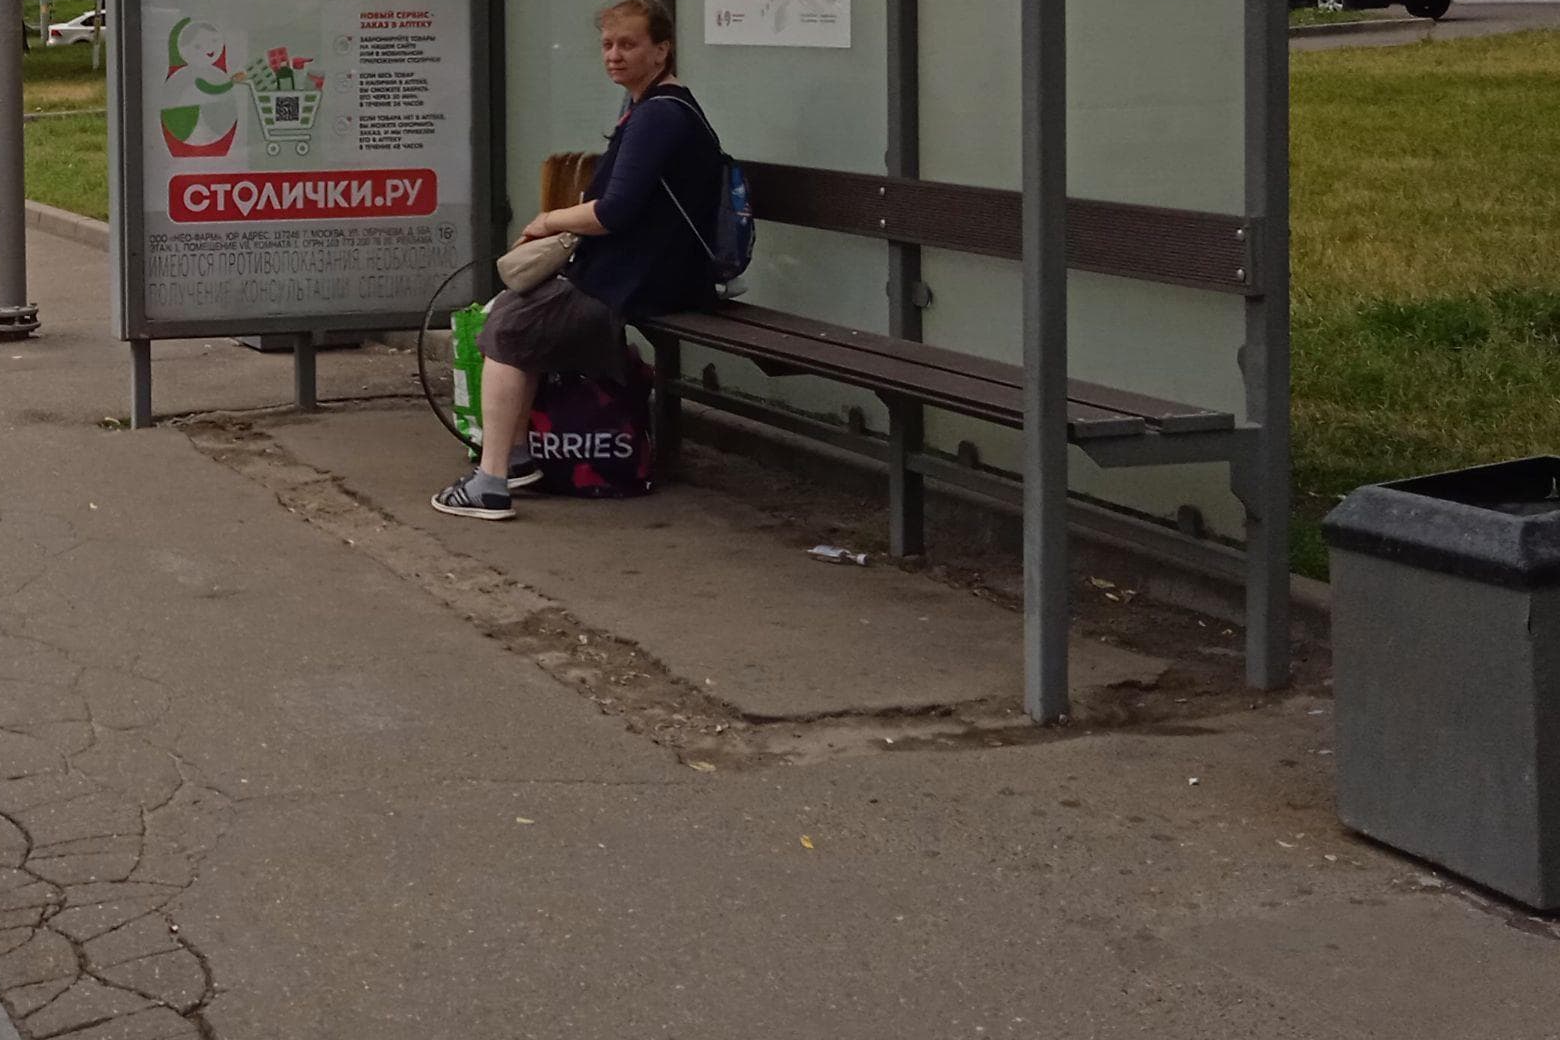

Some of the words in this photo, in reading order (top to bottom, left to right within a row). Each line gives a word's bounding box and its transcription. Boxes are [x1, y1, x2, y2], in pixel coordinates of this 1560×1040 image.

[359, 10, 394, 19] НОВЫЙ
[396, 10, 429, 19] СЕРВИС
[359, 21, 389, 29] ЗАКАЗ
[183, 177, 423, 217] СТОЛИЧКИ.РУ
[150, 234, 168, 244] ООО
[148, 253, 214, 279] ИМЕЮТСЯ
